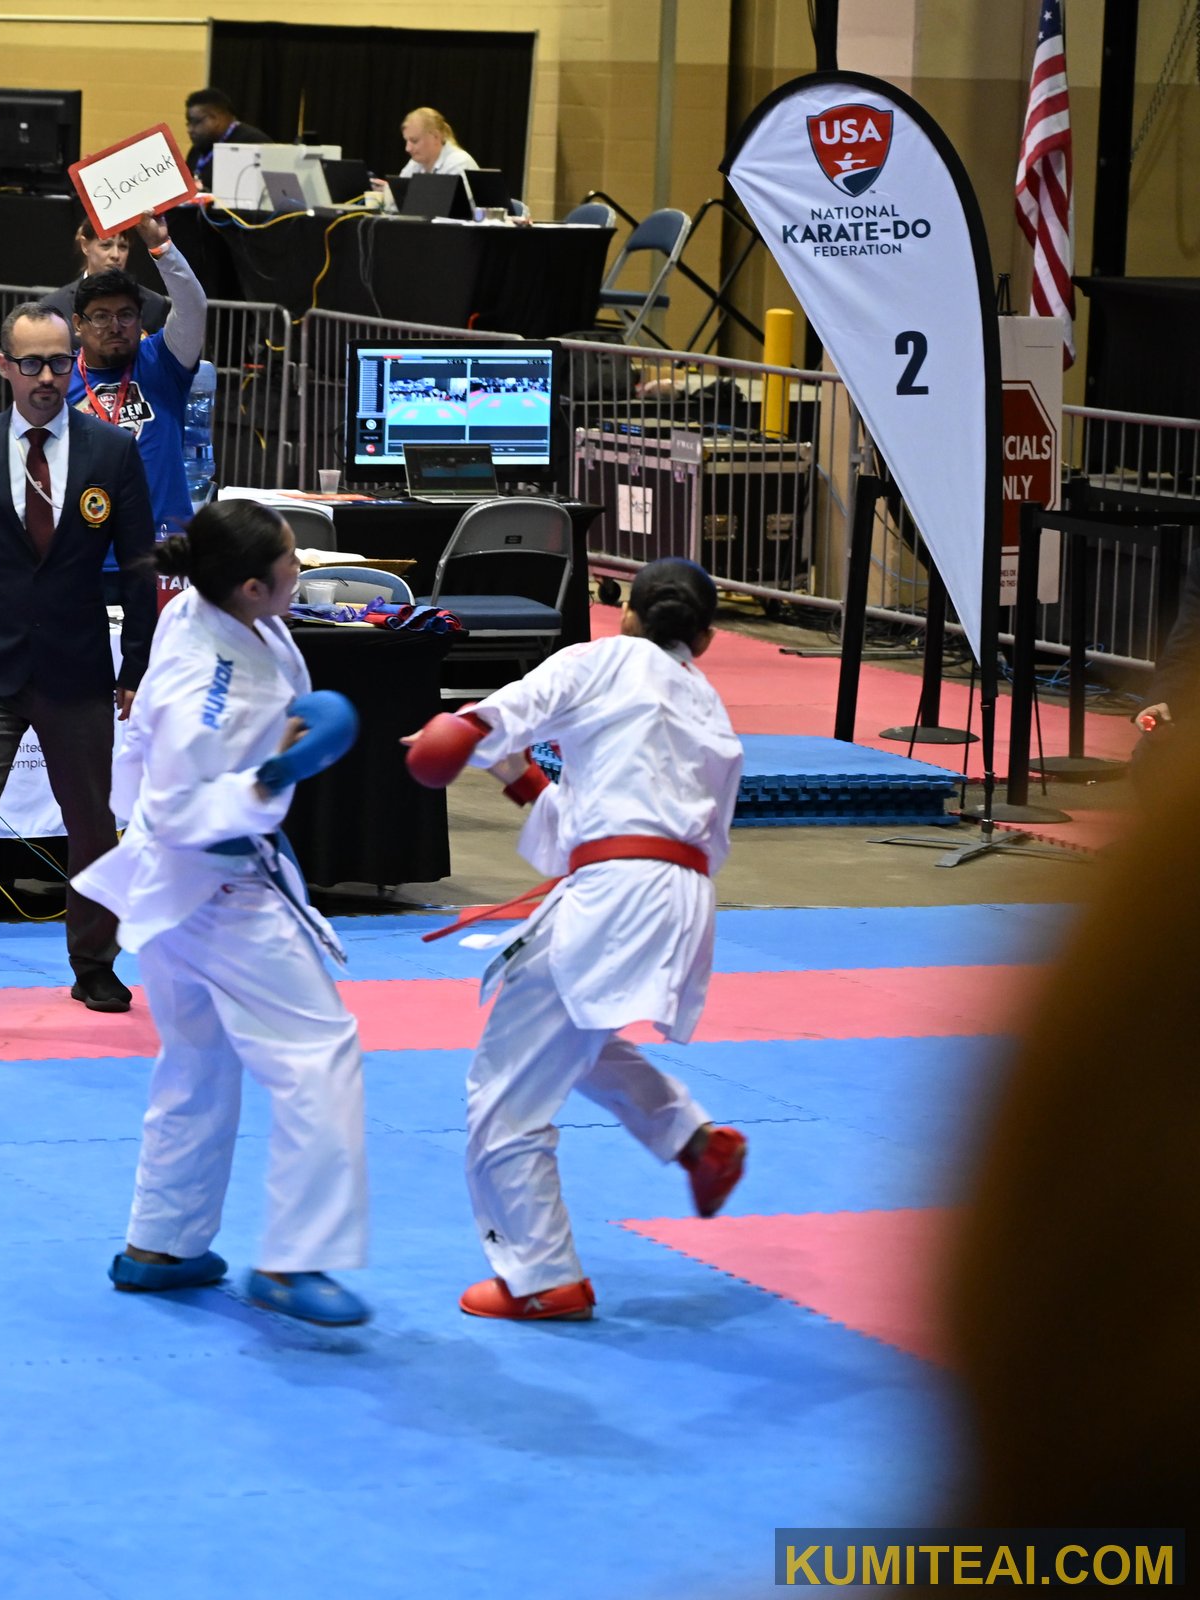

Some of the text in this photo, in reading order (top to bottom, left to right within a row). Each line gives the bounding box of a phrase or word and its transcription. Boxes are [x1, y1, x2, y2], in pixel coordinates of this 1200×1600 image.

[819, 118, 882, 145] USA
[93, 154, 175, 210] Starchak
[810, 204, 900, 221] NATIONAL
[782, 218, 931, 244] KARATE-DO
[813, 243, 902, 257] FEDERATION
[894, 330, 929, 395] 2
[119, 403, 144, 419] PEN
[1002, 435, 1051, 461] CIALS
[1002, 474, 1034, 501] NLY
[11, 757, 47, 771] ympic
